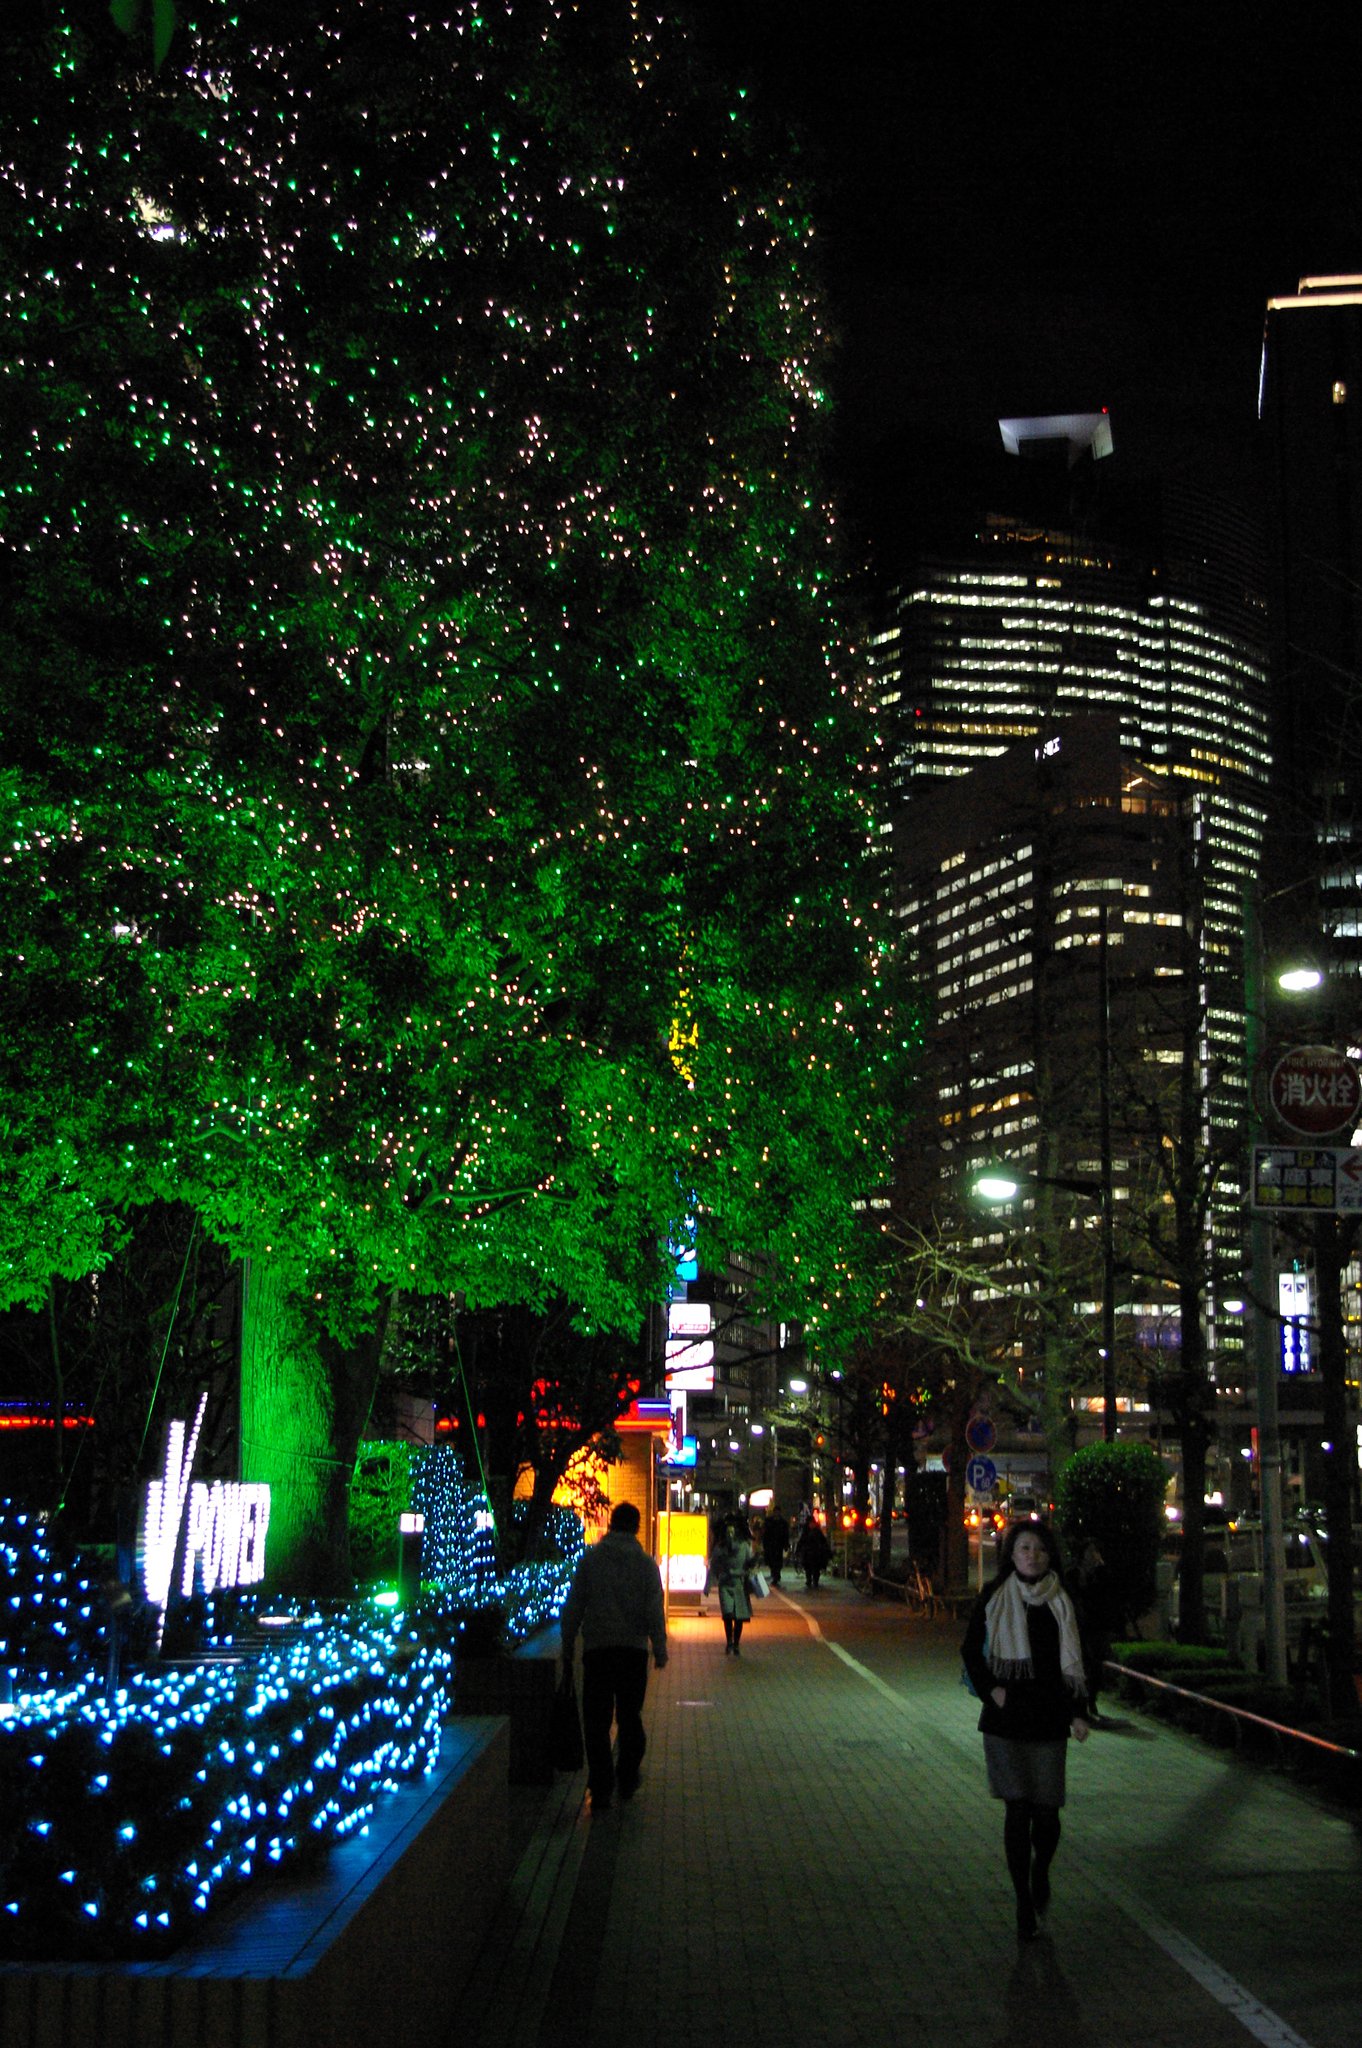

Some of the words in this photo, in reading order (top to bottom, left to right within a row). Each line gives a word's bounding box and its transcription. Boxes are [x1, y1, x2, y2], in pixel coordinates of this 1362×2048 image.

[1280, 1071, 1354, 1107] 消火栓
[973, 1464, 985, 1490] P
